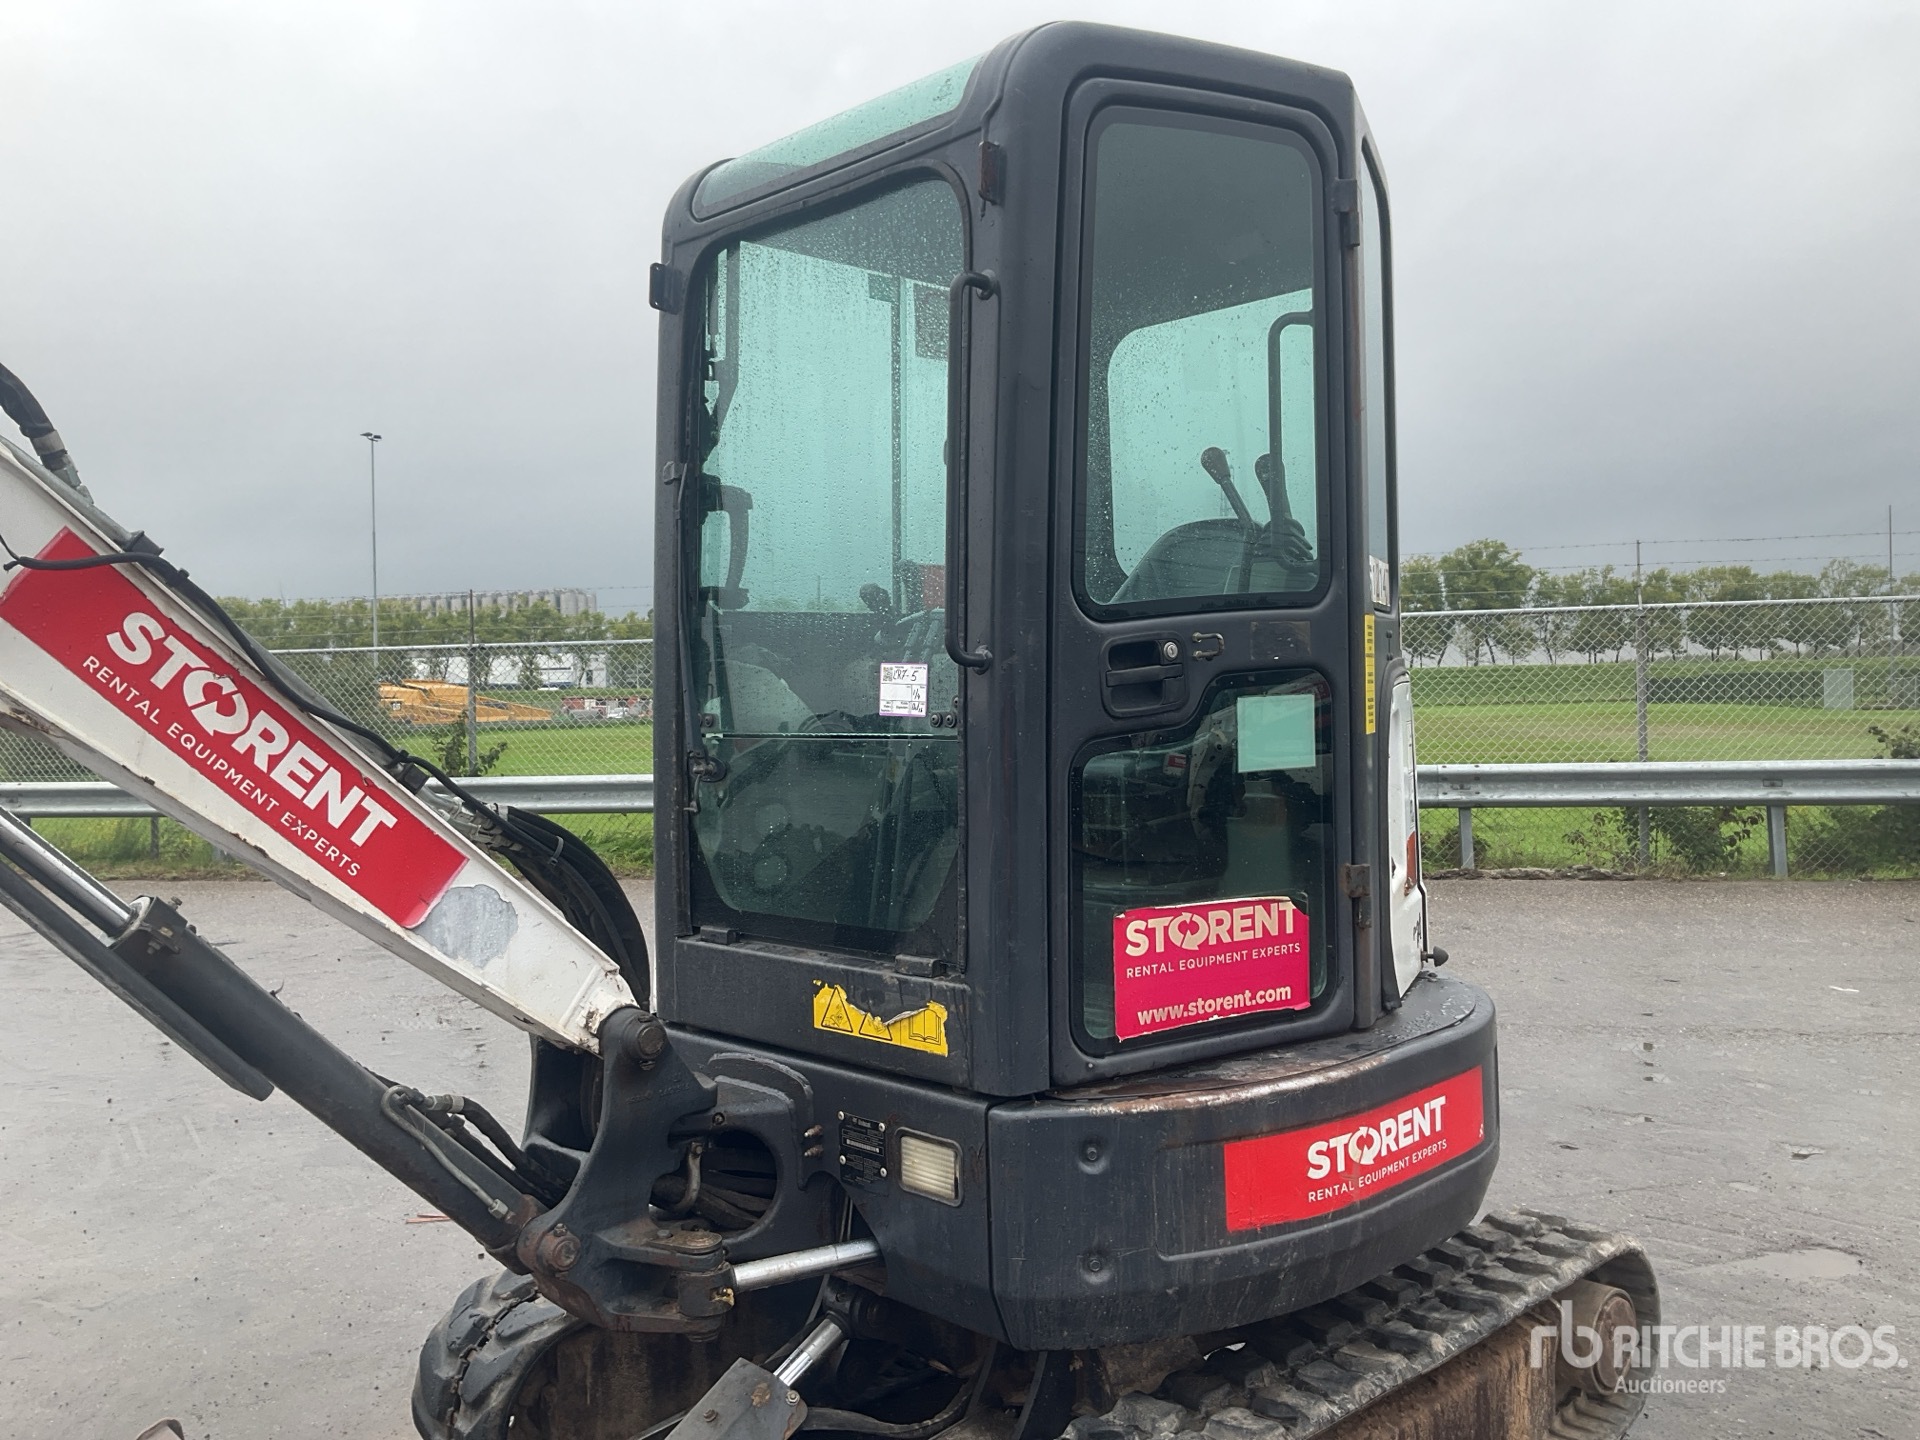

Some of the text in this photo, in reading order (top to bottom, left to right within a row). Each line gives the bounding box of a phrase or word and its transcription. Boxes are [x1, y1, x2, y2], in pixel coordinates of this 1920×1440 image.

[106, 612, 398, 847] STORENT
[82, 655, 361, 877] RENTAL EQUIPMENT EXPERTS
[1125, 902, 1297, 956] STORENT
[1126, 942, 1301, 979] RENTAL EQUIPMENT EXPERTS
[1137, 985, 1292, 1026] www.storent.com
[1307, 1095, 1446, 1180] STORENT
[1308, 1139, 1447, 1203] RENTAL EQUIPMENT EXPERTS
